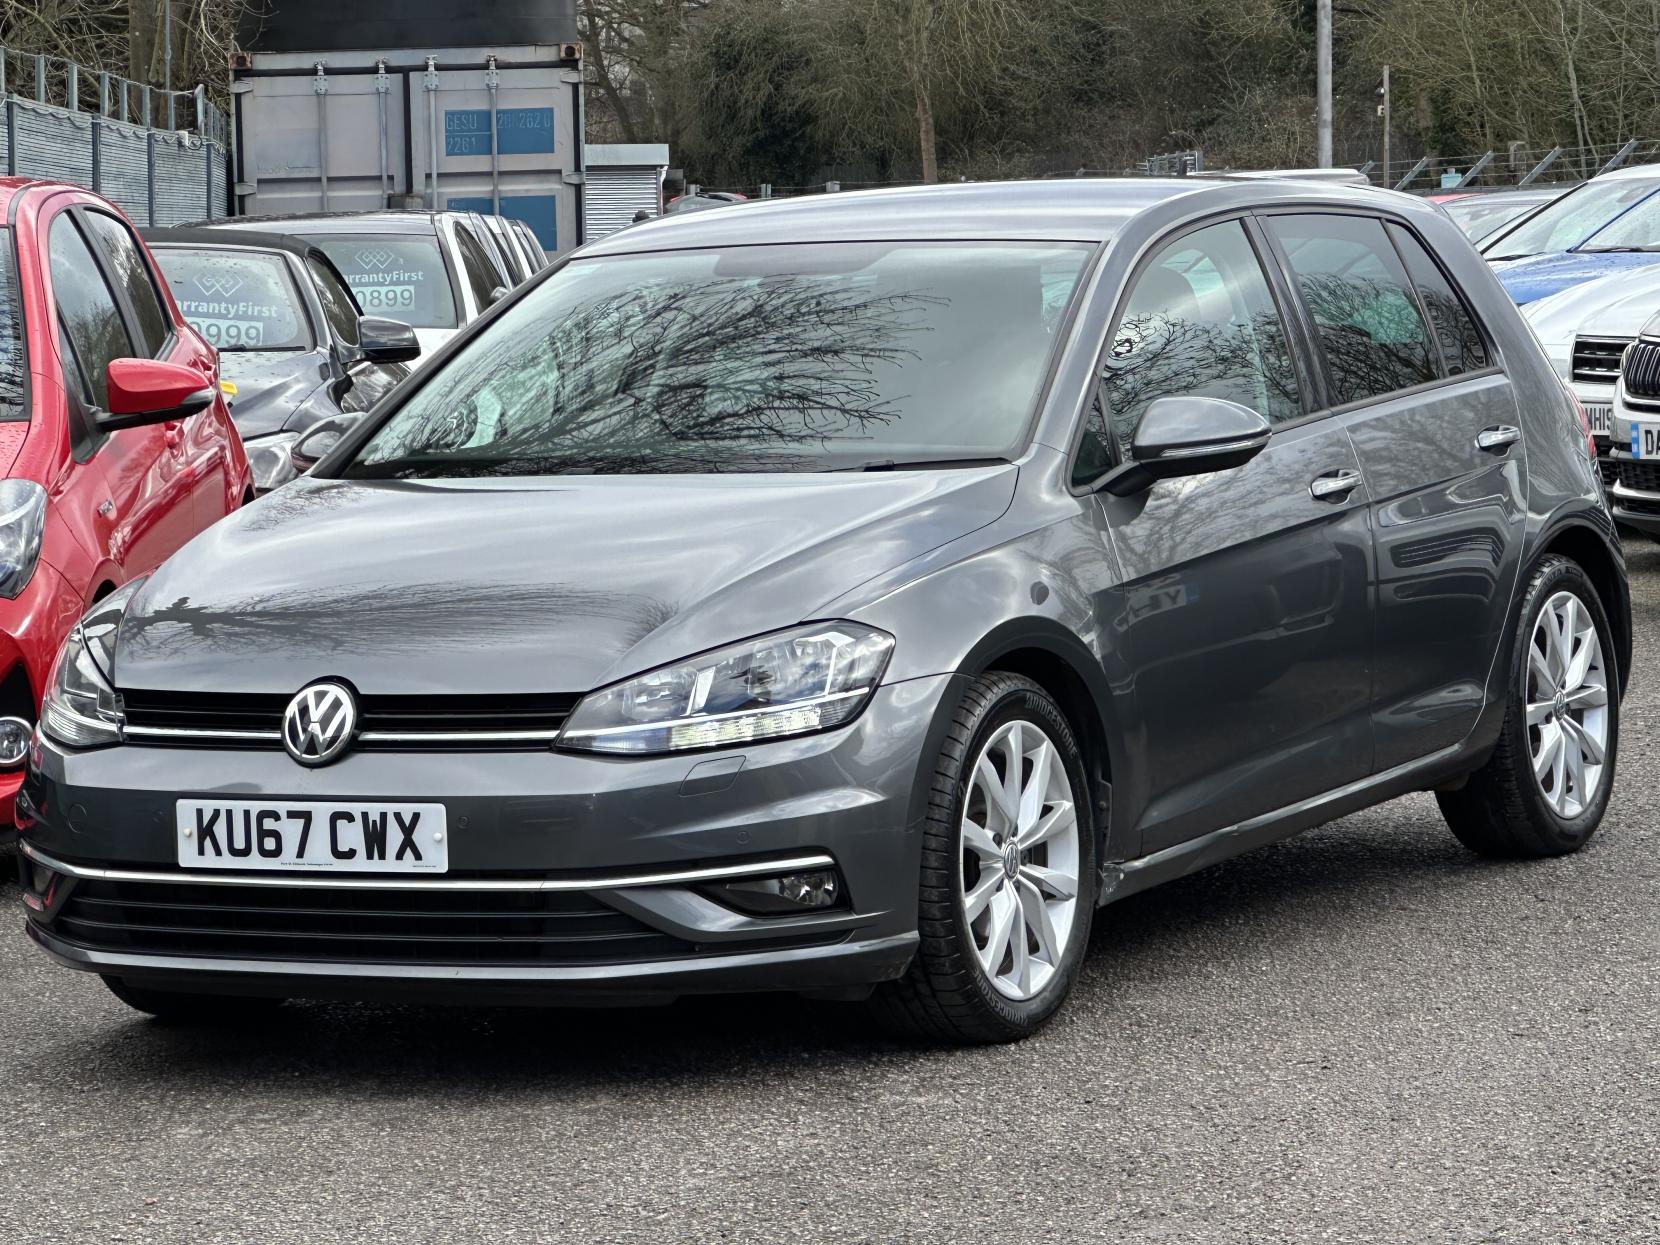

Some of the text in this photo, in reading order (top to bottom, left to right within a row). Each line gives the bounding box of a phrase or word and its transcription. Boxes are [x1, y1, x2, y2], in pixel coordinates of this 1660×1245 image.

[446, 113, 477, 130] GESU
[344, 270, 424, 285] arrantyFirst
[176, 299, 279, 318] arrantyFirst
[195, 808, 423, 861] KU67 CWX
